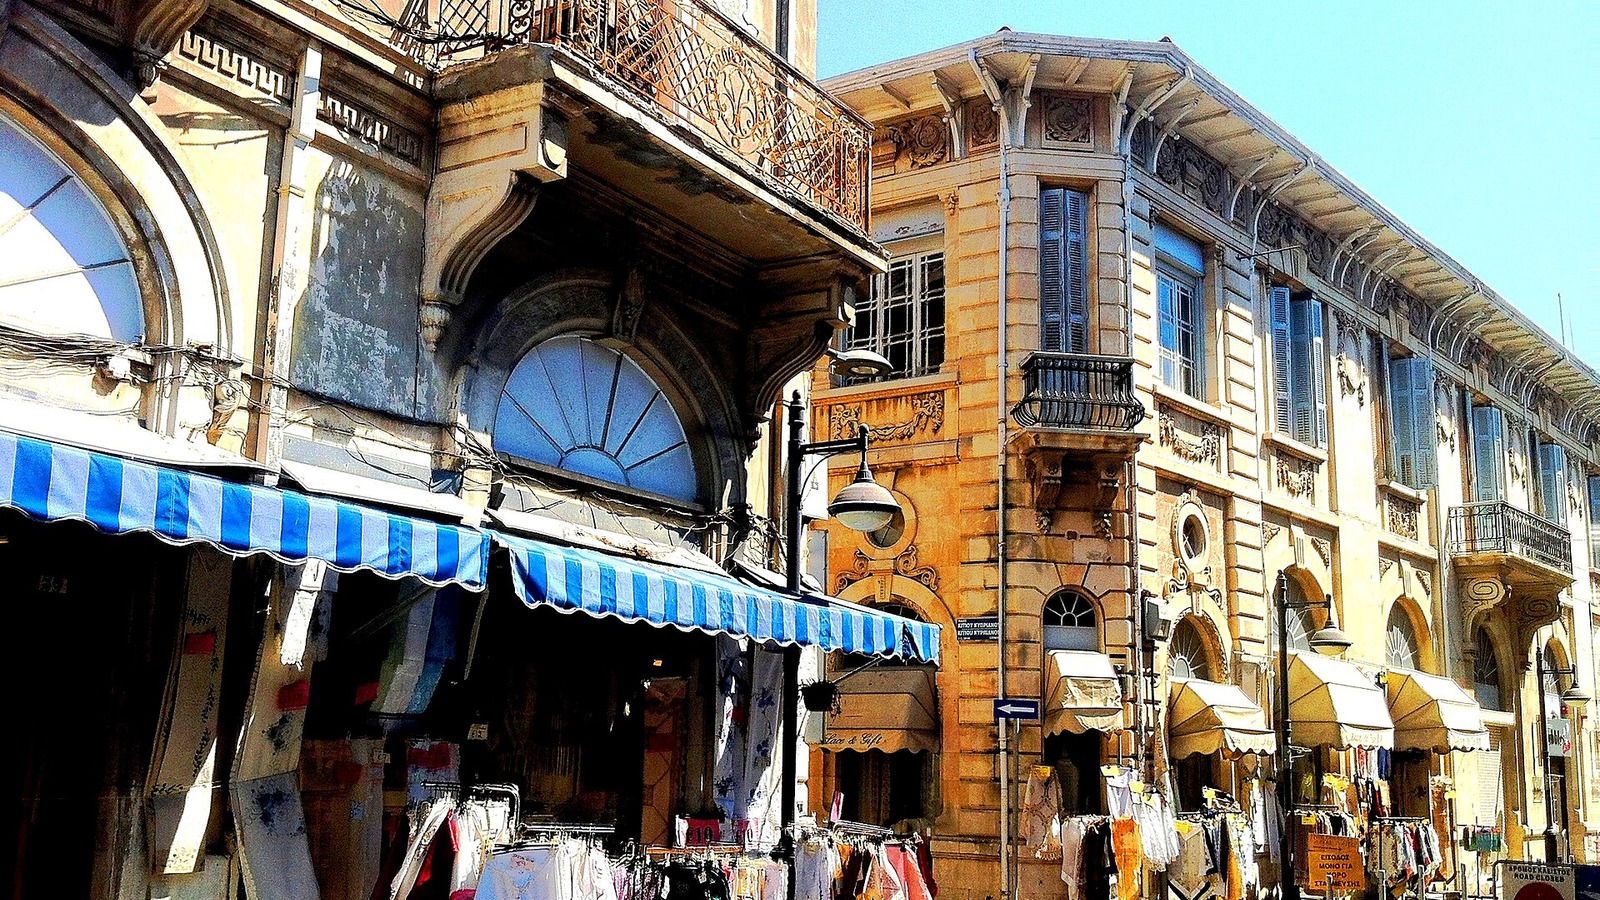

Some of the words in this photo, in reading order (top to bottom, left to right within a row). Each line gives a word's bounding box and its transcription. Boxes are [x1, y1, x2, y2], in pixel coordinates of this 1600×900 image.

[848, 736, 857, 745] &
[860, 733, 882, 748] Gift
[1514, 872, 1534, 880] ROAD
[1536, 874, 1565, 883] CLOSED
